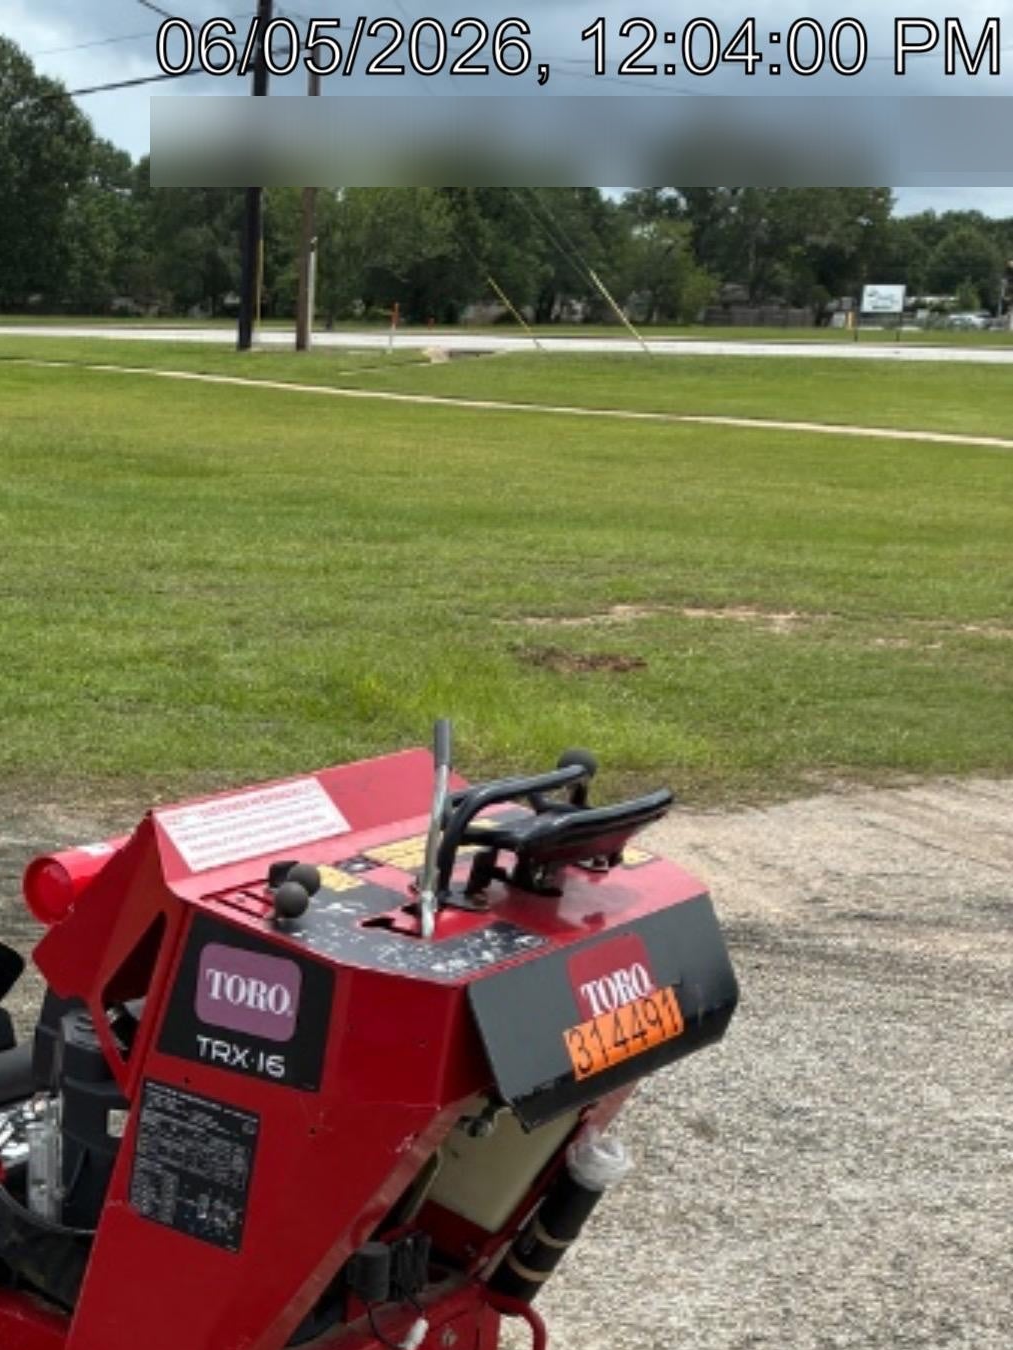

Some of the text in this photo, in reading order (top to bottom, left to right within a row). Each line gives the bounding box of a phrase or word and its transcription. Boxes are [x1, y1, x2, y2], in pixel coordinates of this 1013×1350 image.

[205, 968, 292, 1016] TORO
[580, 962, 652, 1017] TORO
[567, 989, 679, 1074] 314491
